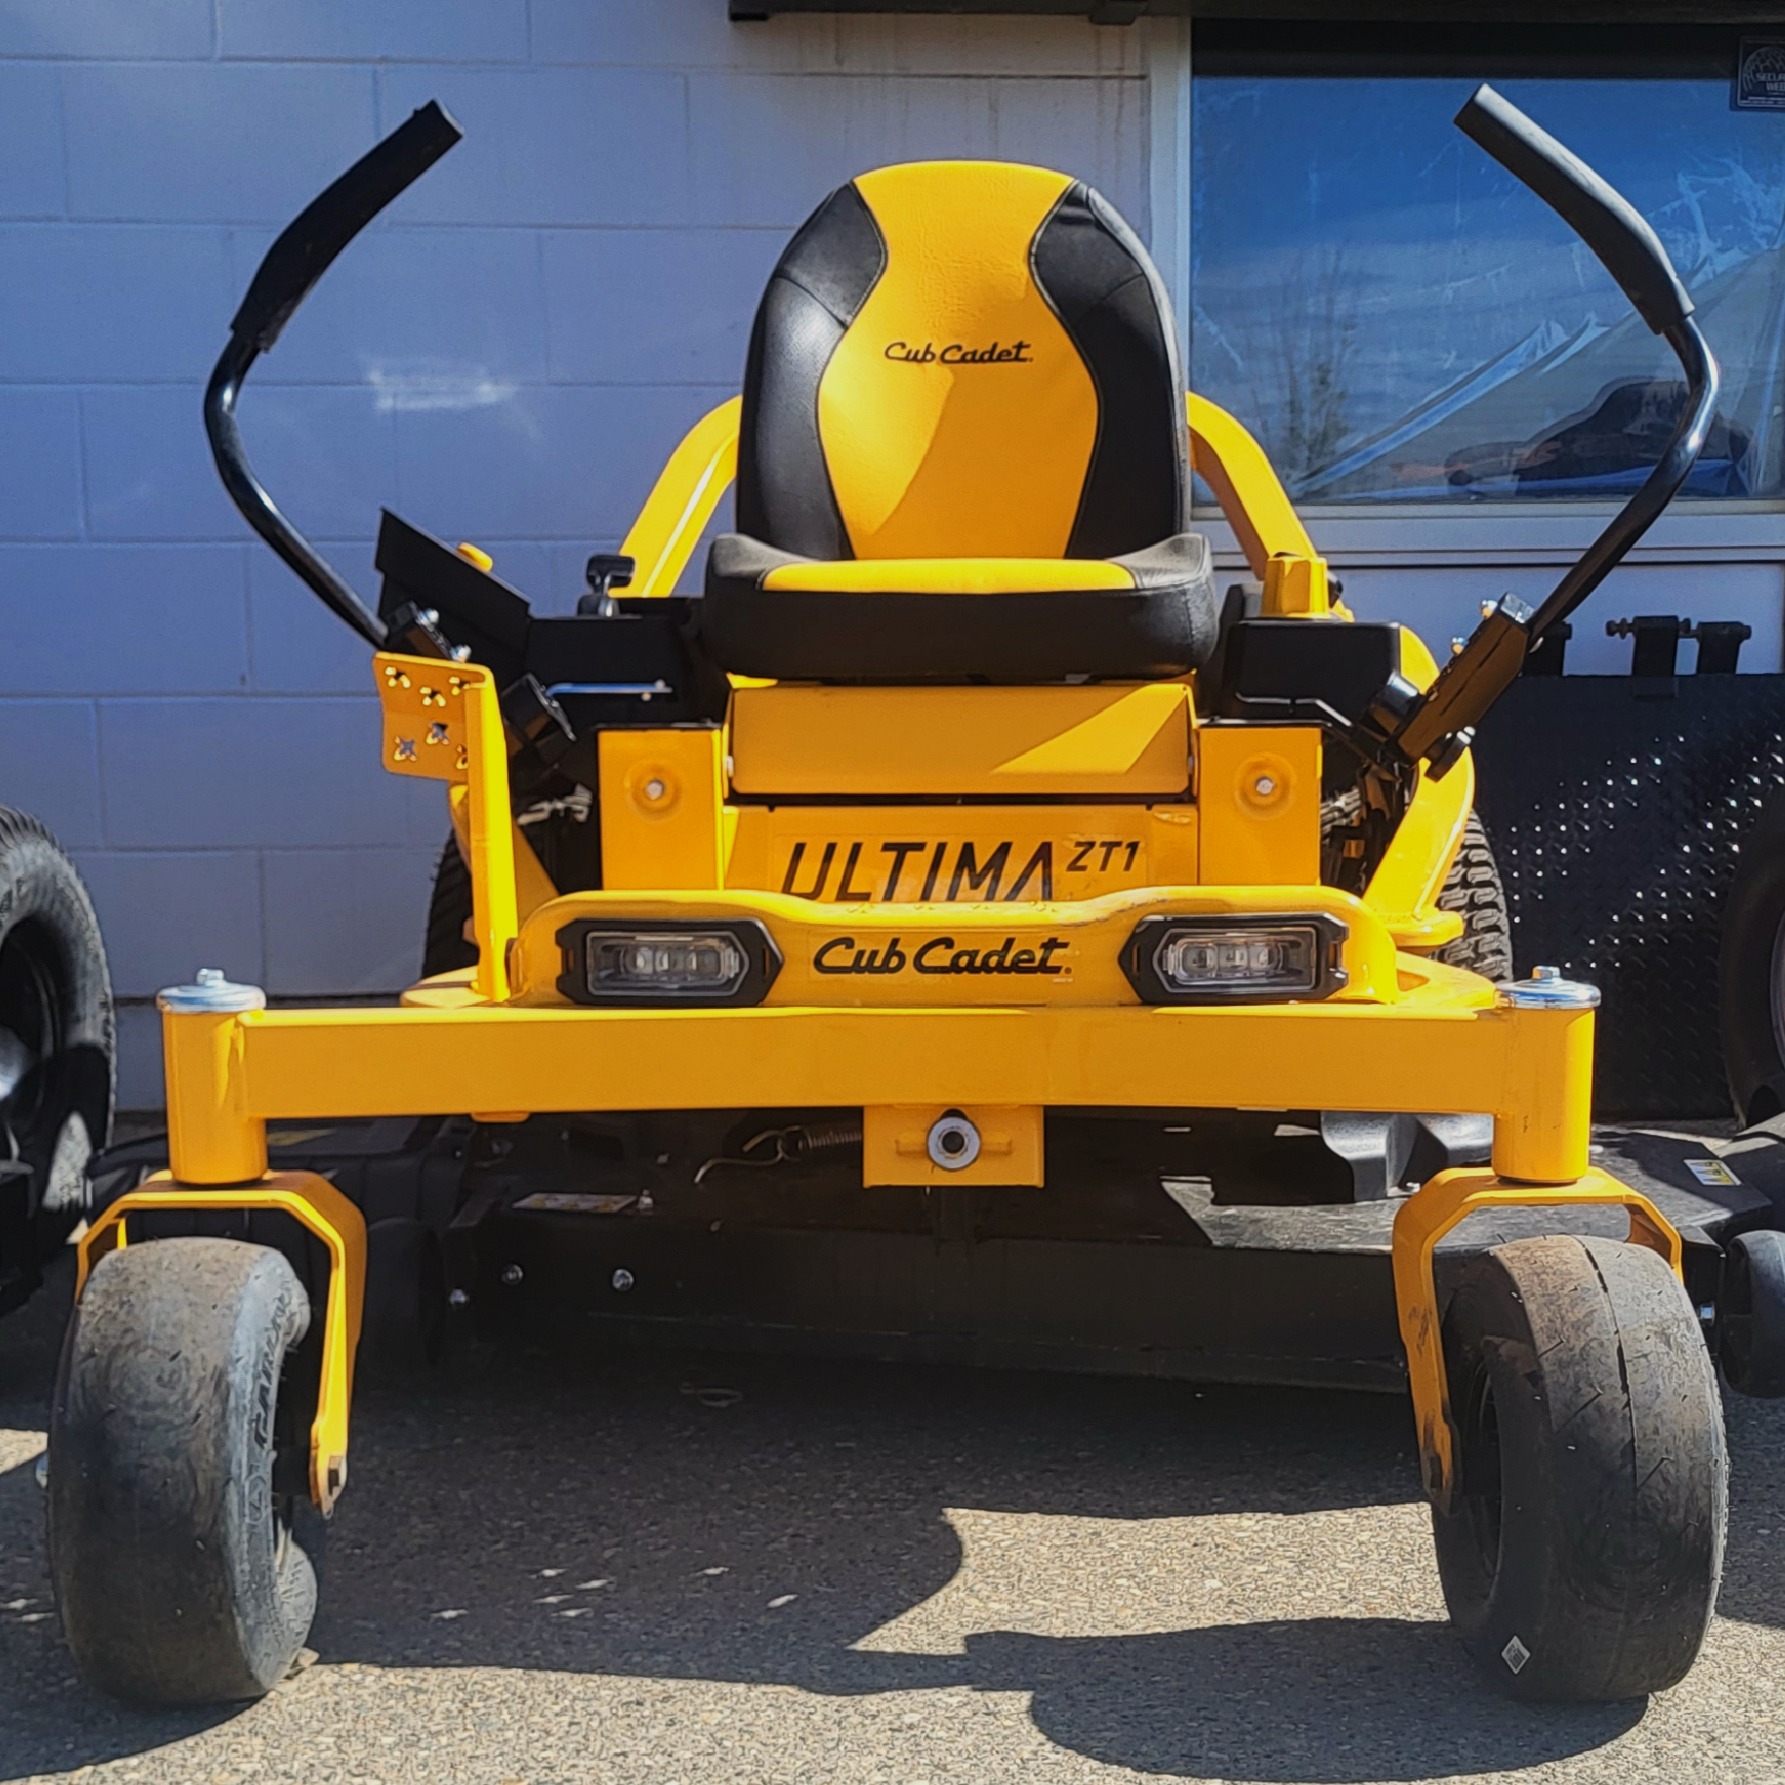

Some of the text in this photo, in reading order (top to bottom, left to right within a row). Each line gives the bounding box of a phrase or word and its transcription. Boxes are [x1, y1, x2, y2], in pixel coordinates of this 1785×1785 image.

[884, 340, 1032, 364] Cub Cadet
[781, 841, 1141, 903] ULTIMA ZT1
[813, 937, 1071, 975] Cub Cadet
